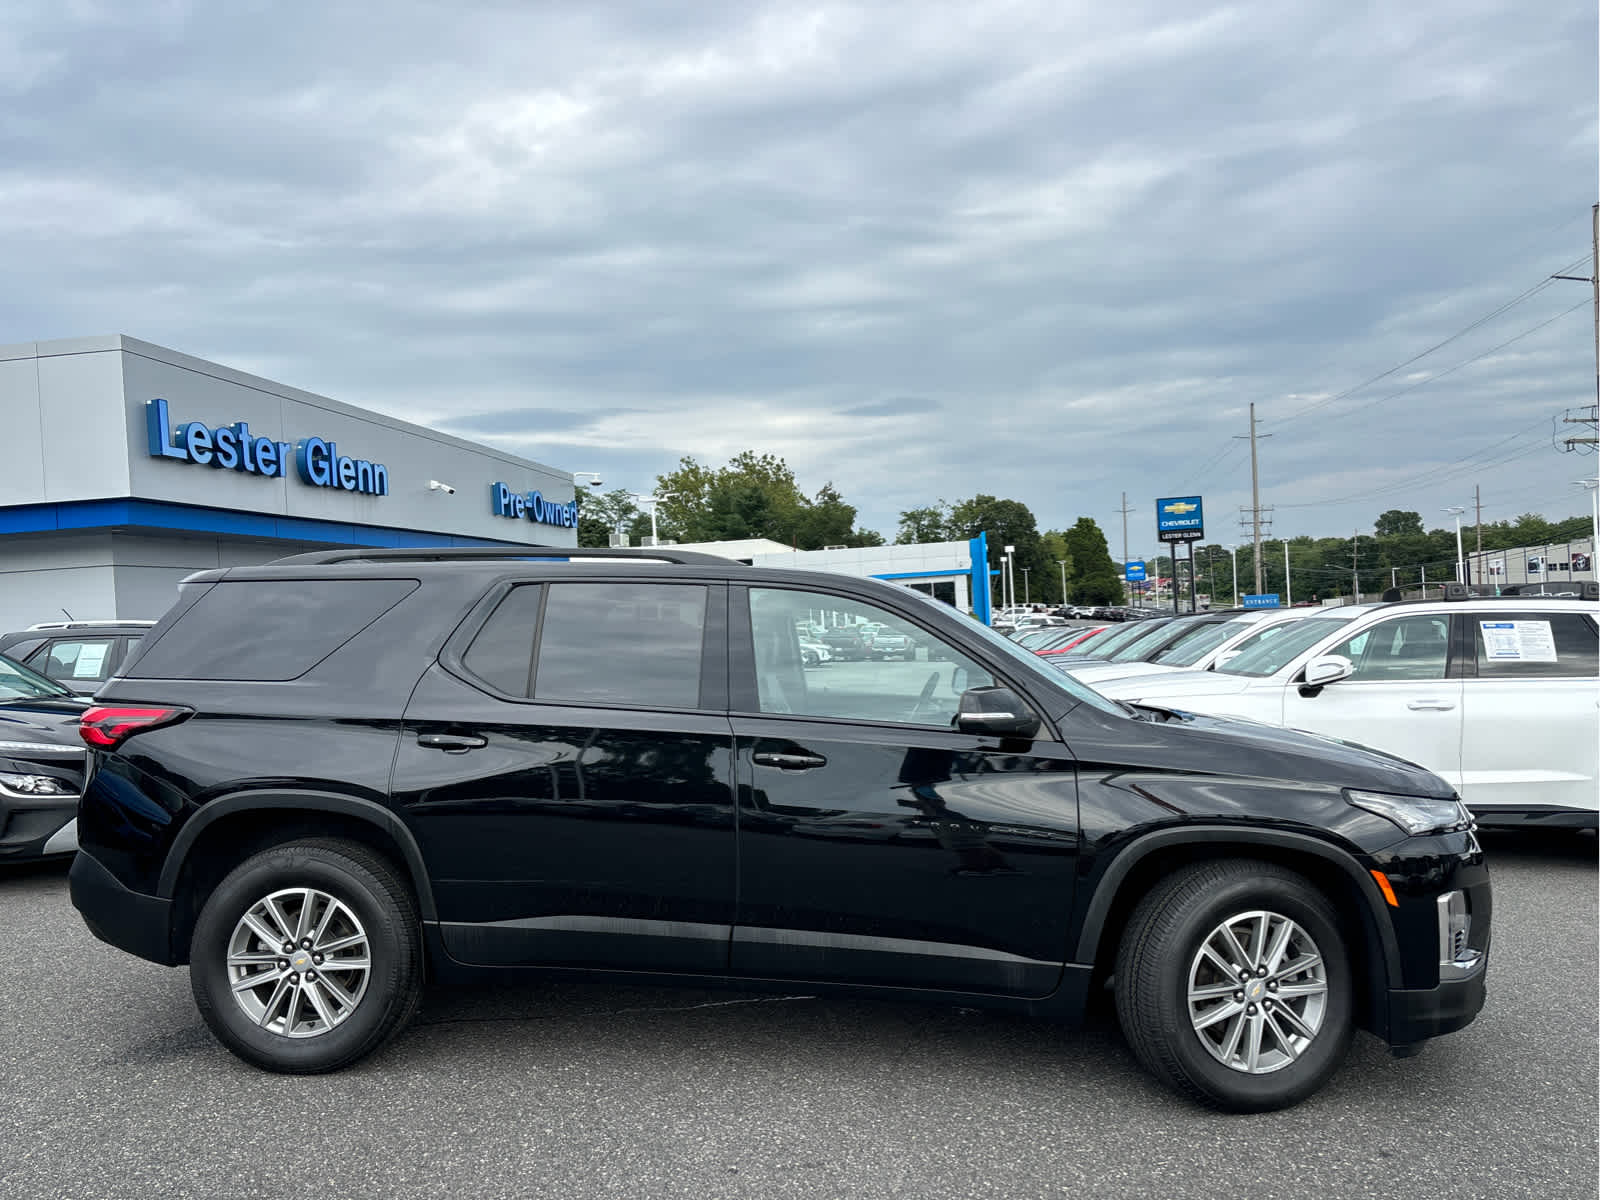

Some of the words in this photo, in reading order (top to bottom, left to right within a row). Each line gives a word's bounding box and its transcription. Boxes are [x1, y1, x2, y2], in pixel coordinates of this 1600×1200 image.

[147, 399, 291, 477] Lester
[297, 436, 389, 496] Glenn
[492, 481, 578, 528] Pre-Owned
